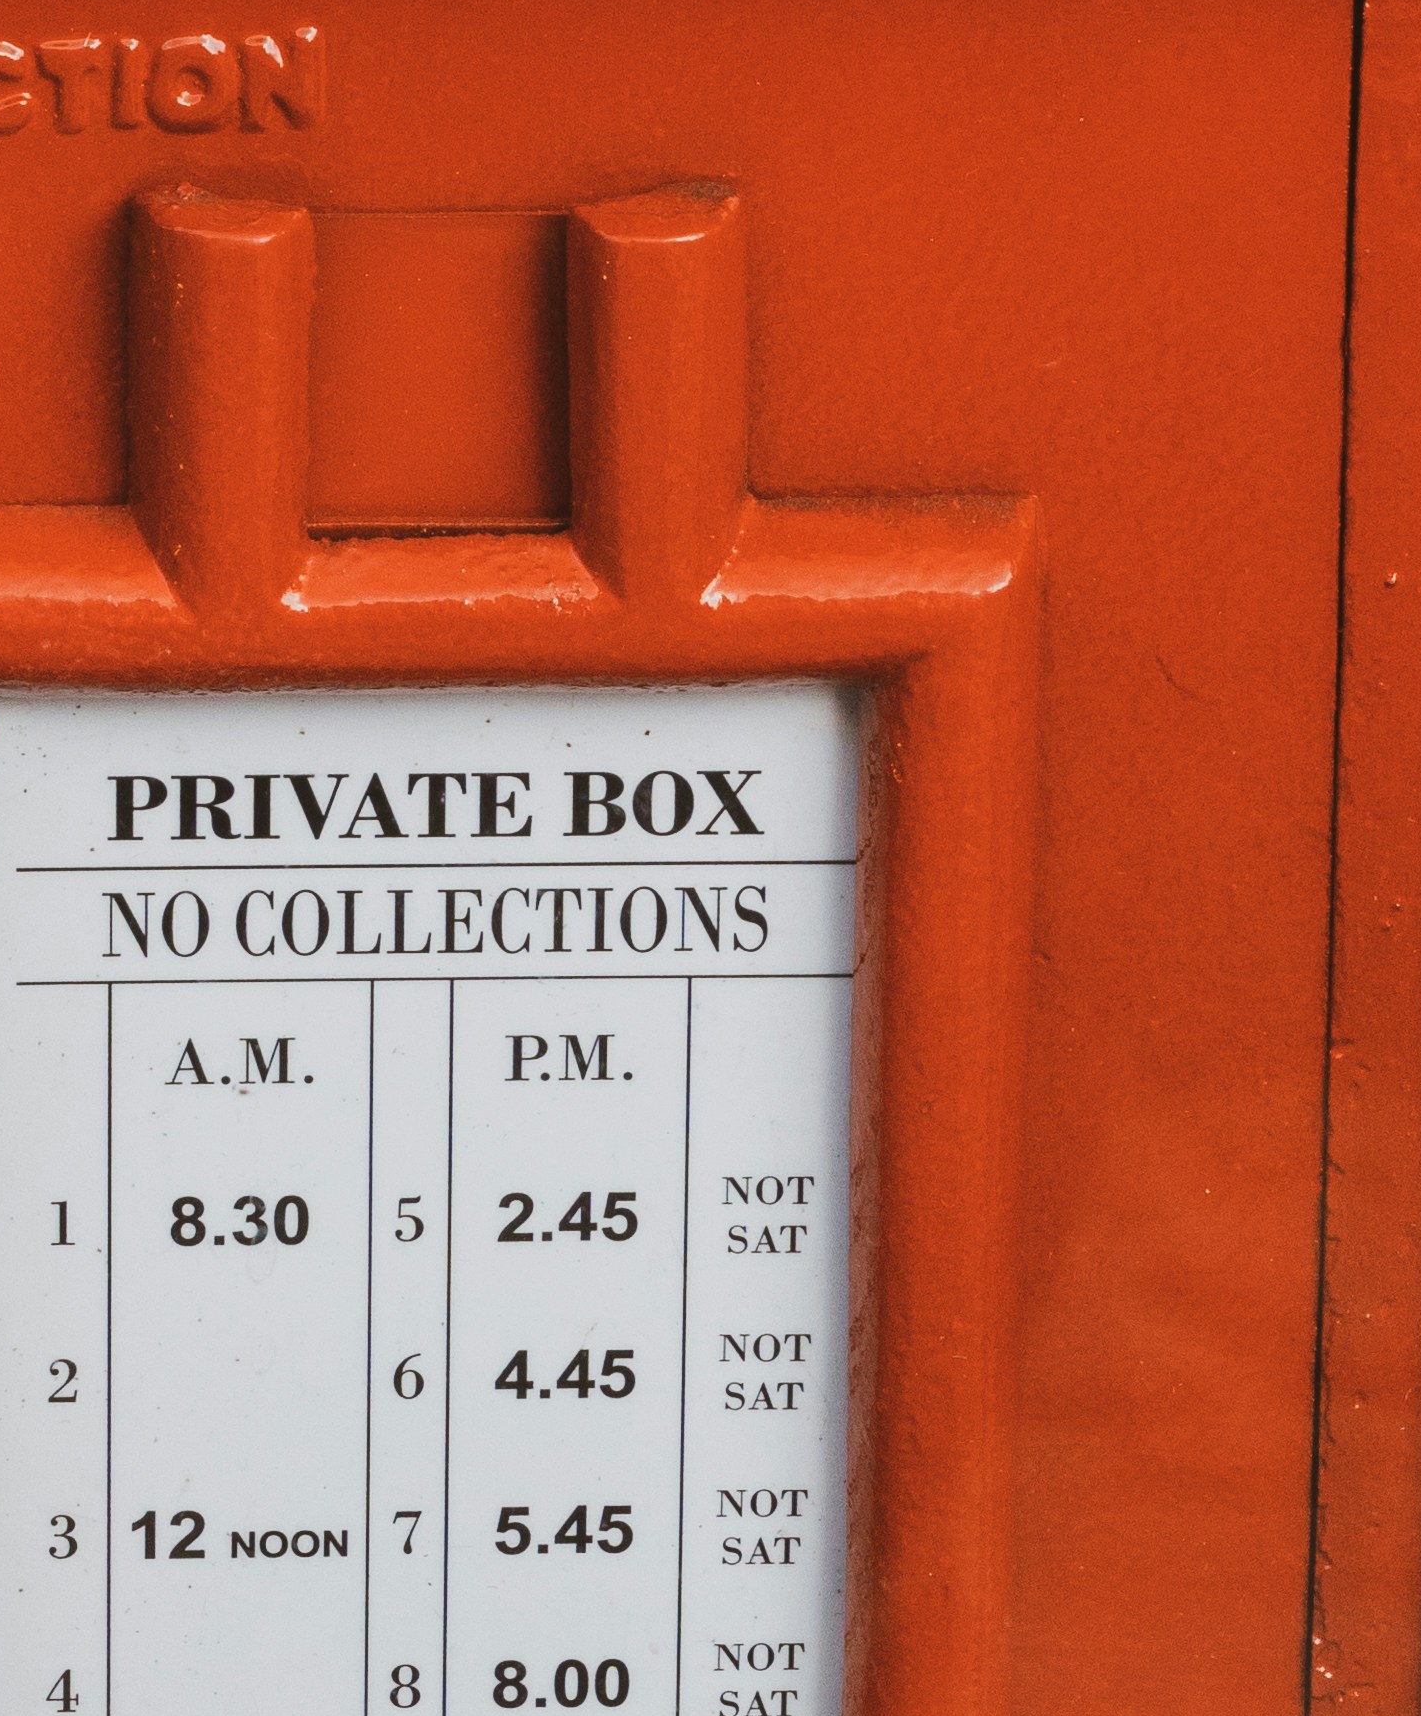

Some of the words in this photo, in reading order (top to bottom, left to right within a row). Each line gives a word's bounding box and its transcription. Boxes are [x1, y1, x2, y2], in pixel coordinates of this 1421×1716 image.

[106, 771, 534, 842] PRIVATE
[561, 769, 766, 838] BOX
[100, 889, 211, 959] NO
[234, 884, 769, 958] COLLECTIONS
[163, 1036, 315, 1086] A.M.
[503, 1033, 634, 1083] P.M.
[722, 1174, 816, 1207] NOT
[49, 1199, 77, 1247] 1
[169, 1194, 311, 1248] 8.30
[394, 1194, 426, 1244] 5
[496, 1190, 639, 1244] 2.45
[726, 1224, 809, 1255] SAT
[718, 1332, 813, 1364] NOT
[47, 1357, 79, 1404] 2
[392, 1352, 426, 1401] 6
[493, 1348, 637, 1401] 4.45
[723, 1381, 806, 1412] SAT
[715, 1487, 810, 1519] NOT
[47, 1513, 79, 1561] 3
[130, 1509, 207, 1561] 12
[230, 1528, 349, 1560] NOON
[391, 1509, 423, 1556] 7
[493, 1503, 635, 1557] 5.45
[721, 1535, 802, 1567] SAT
[713, 1641, 807, 1673] NOT
[44, 1667, 80, 1714] 4
[388, 1663, 422, 1710] 8
[491, 1657, 631, 1710] 8.00
